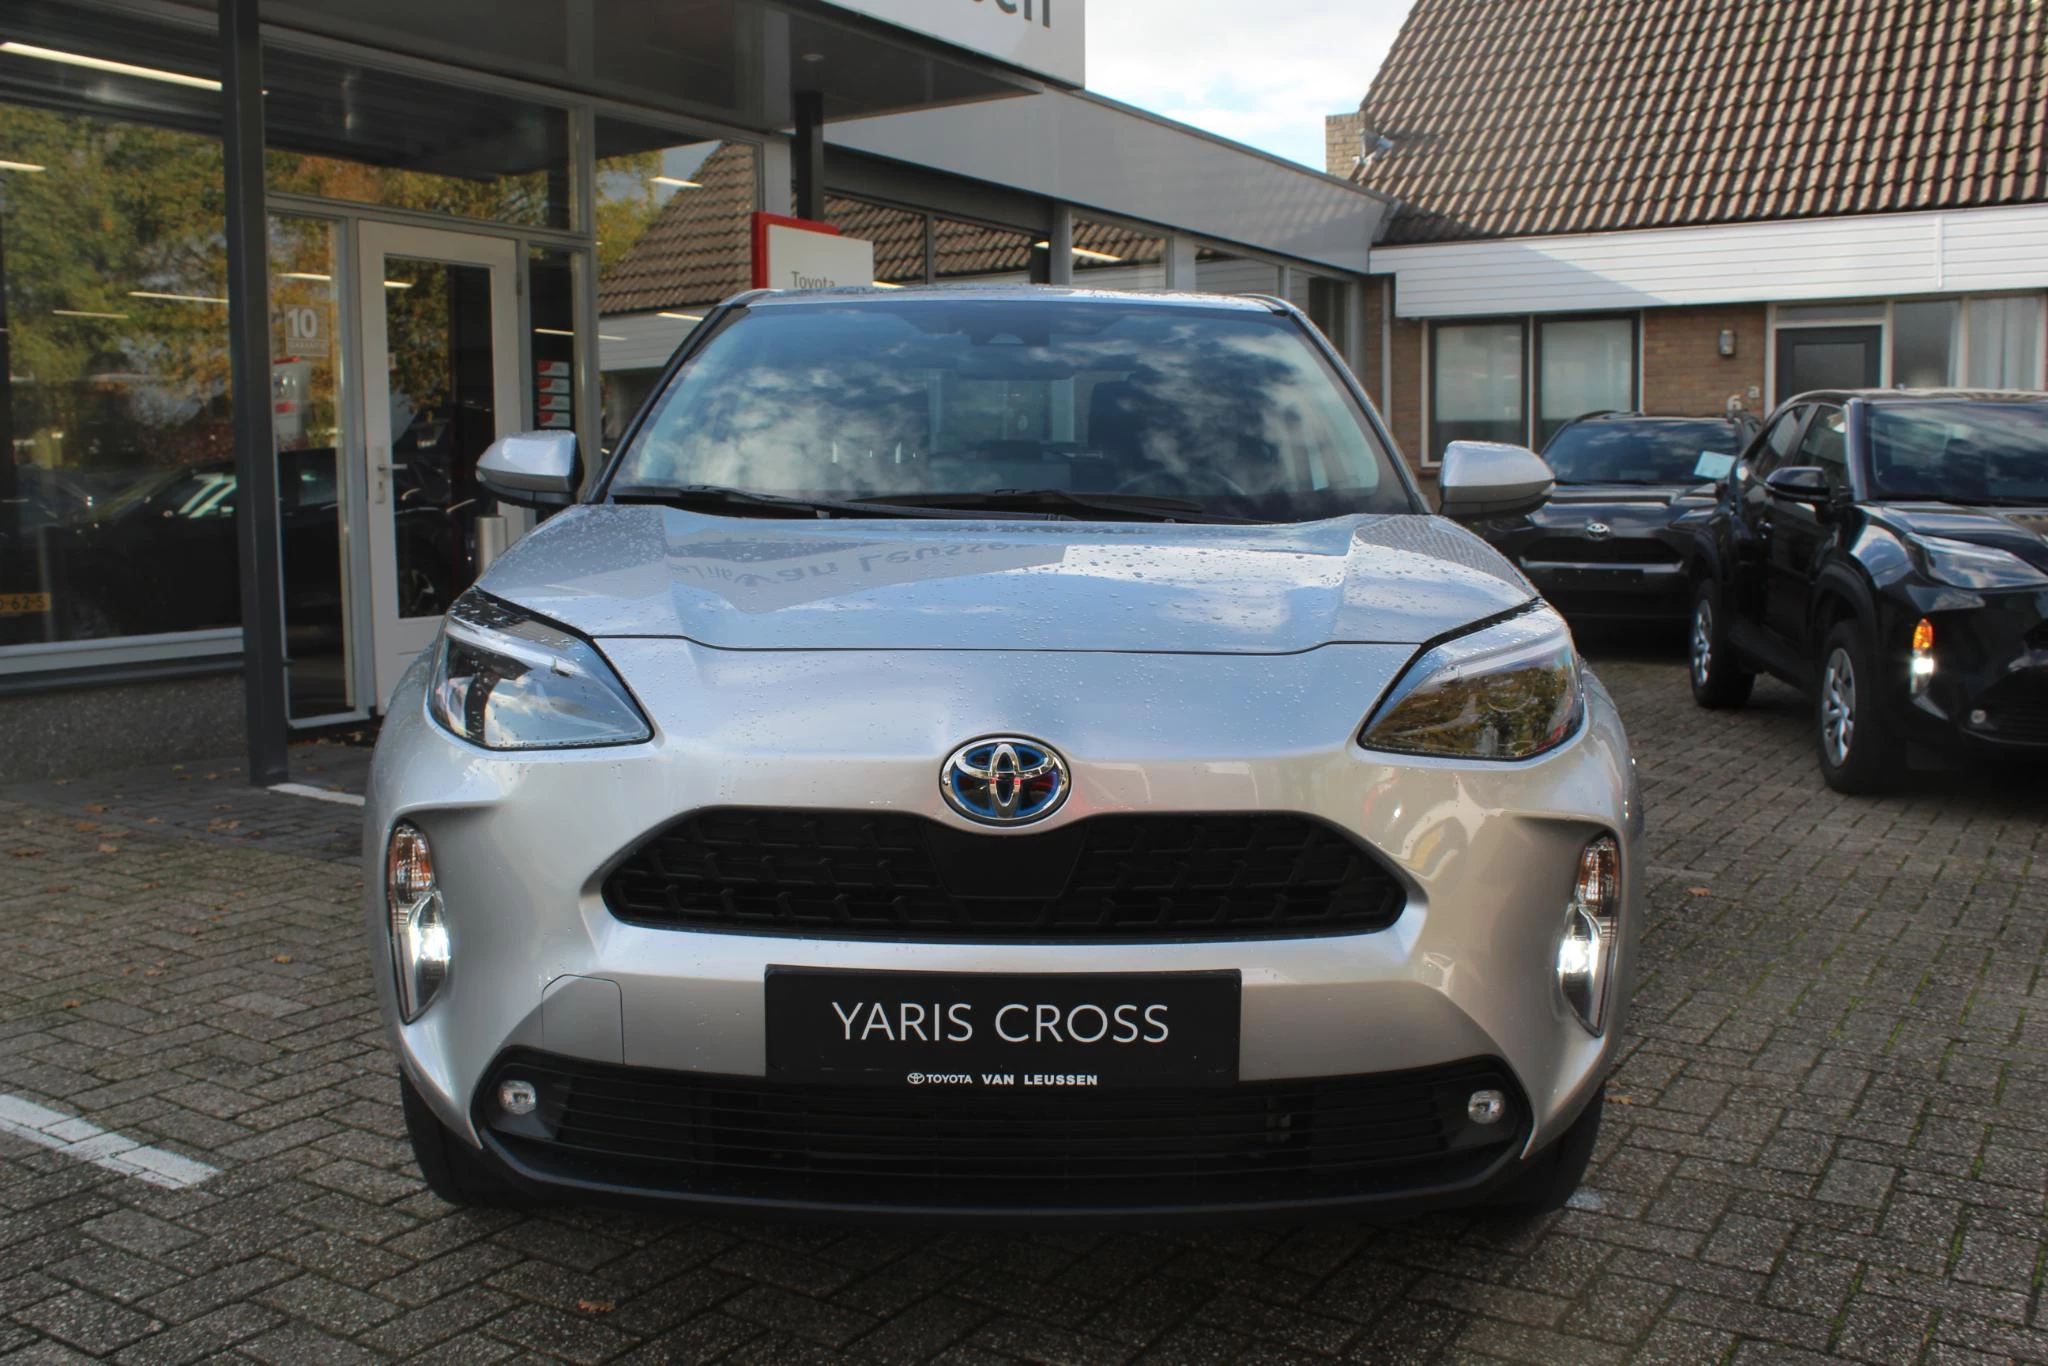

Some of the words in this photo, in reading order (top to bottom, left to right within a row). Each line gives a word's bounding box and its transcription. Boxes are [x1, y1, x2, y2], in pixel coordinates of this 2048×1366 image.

[791, 271, 835, 289] Toyota
[287, 308, 318, 338] 10
[832, 1002, 973, 1042] YARIS
[995, 1004, 1169, 1043] CROSS
[926, 1074, 973, 1084] TOYOTA
[982, 1074, 1014, 1085] VAN
[1024, 1074, 1097, 1086] LEUSSEN
